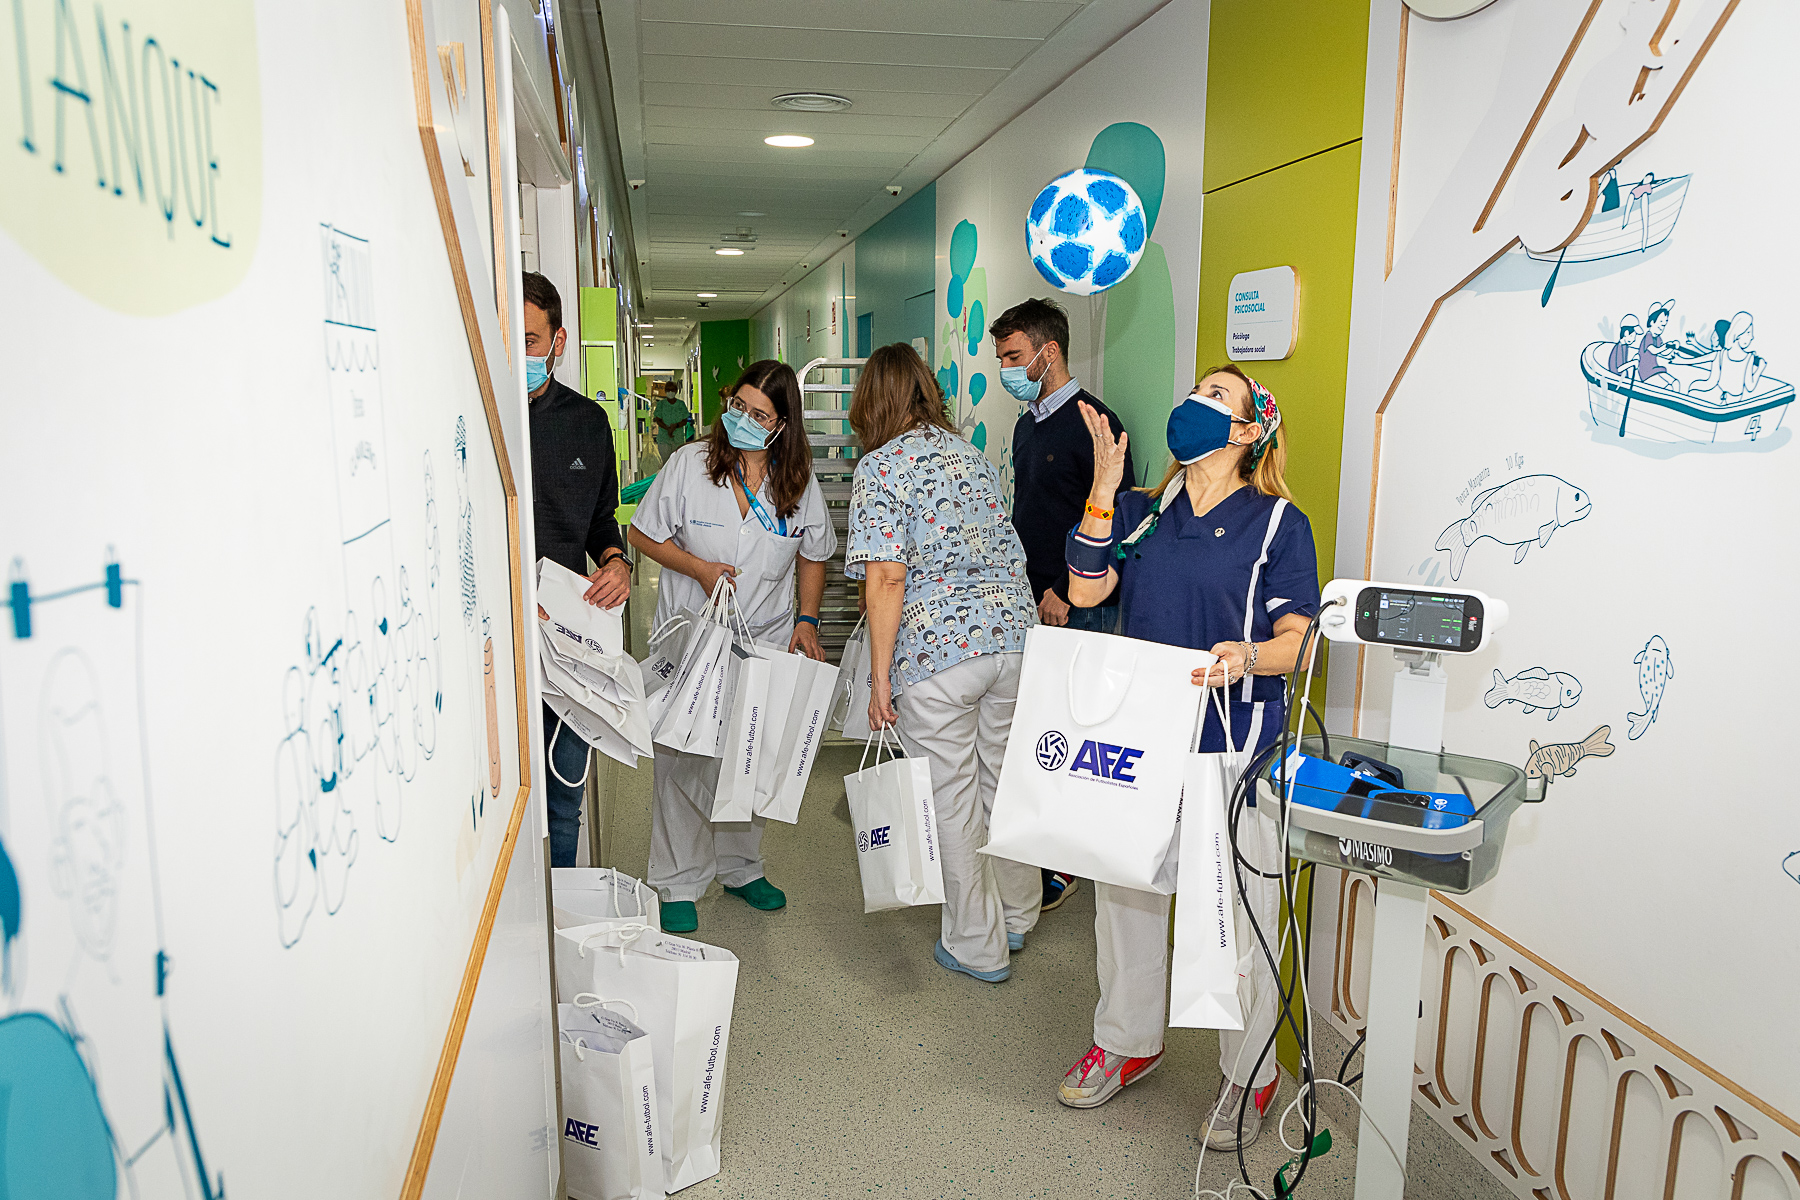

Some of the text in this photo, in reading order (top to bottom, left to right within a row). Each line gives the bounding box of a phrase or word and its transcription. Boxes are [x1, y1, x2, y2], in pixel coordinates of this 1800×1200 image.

[1234, 290, 1260, 302] CONSULTA
[1234, 302, 1266, 314] PSICOSOCIAL
[1231, 345, 1266, 355] Trabajadora social
[1744, 414, 1762, 442] 4
[687, 662, 711, 715] www.afe-futbol.com
[744, 706, 759, 775] www.afe-futbol.com
[796, 709, 820, 777] www.afe-futbol.com
[1069, 739, 1145, 783] AFE
[870, 825, 891, 848] AFE
[922, 798, 935, 862] www.afe-futbol.com
[1352, 839, 1393, 866] MASIMO
[1214, 832, 1228, 948] www.afe-futbol.com
[700, 1025, 722, 1114] www.afe-futbol.com
[564, 1117, 600, 1147] AFE
[642, 1085, 655, 1156] www.afe-futbol.com
